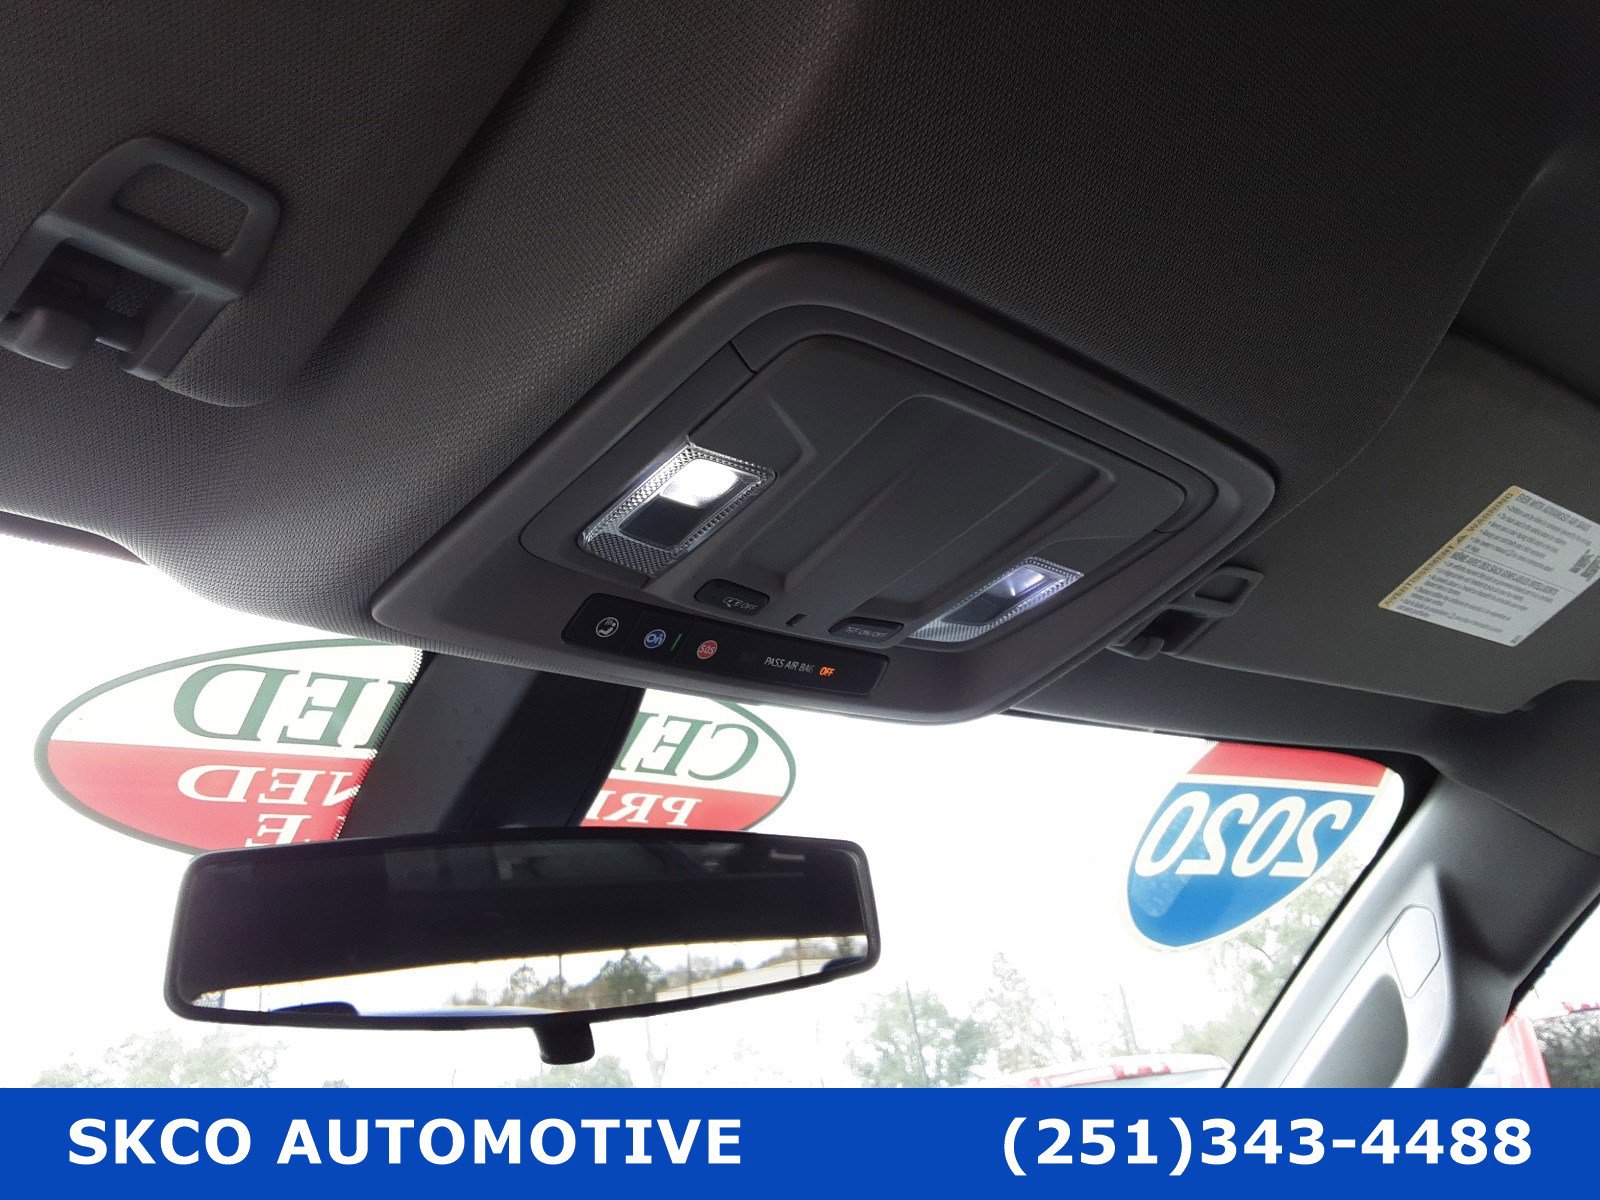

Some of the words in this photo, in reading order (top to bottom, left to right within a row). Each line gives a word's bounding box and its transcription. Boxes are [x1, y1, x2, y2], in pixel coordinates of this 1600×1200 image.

[699, 644, 715, 655] SOS
[764, 656, 785, 668] PASS
[784, 660, 801, 670] AIR
[819, 666, 836, 676] OFF
